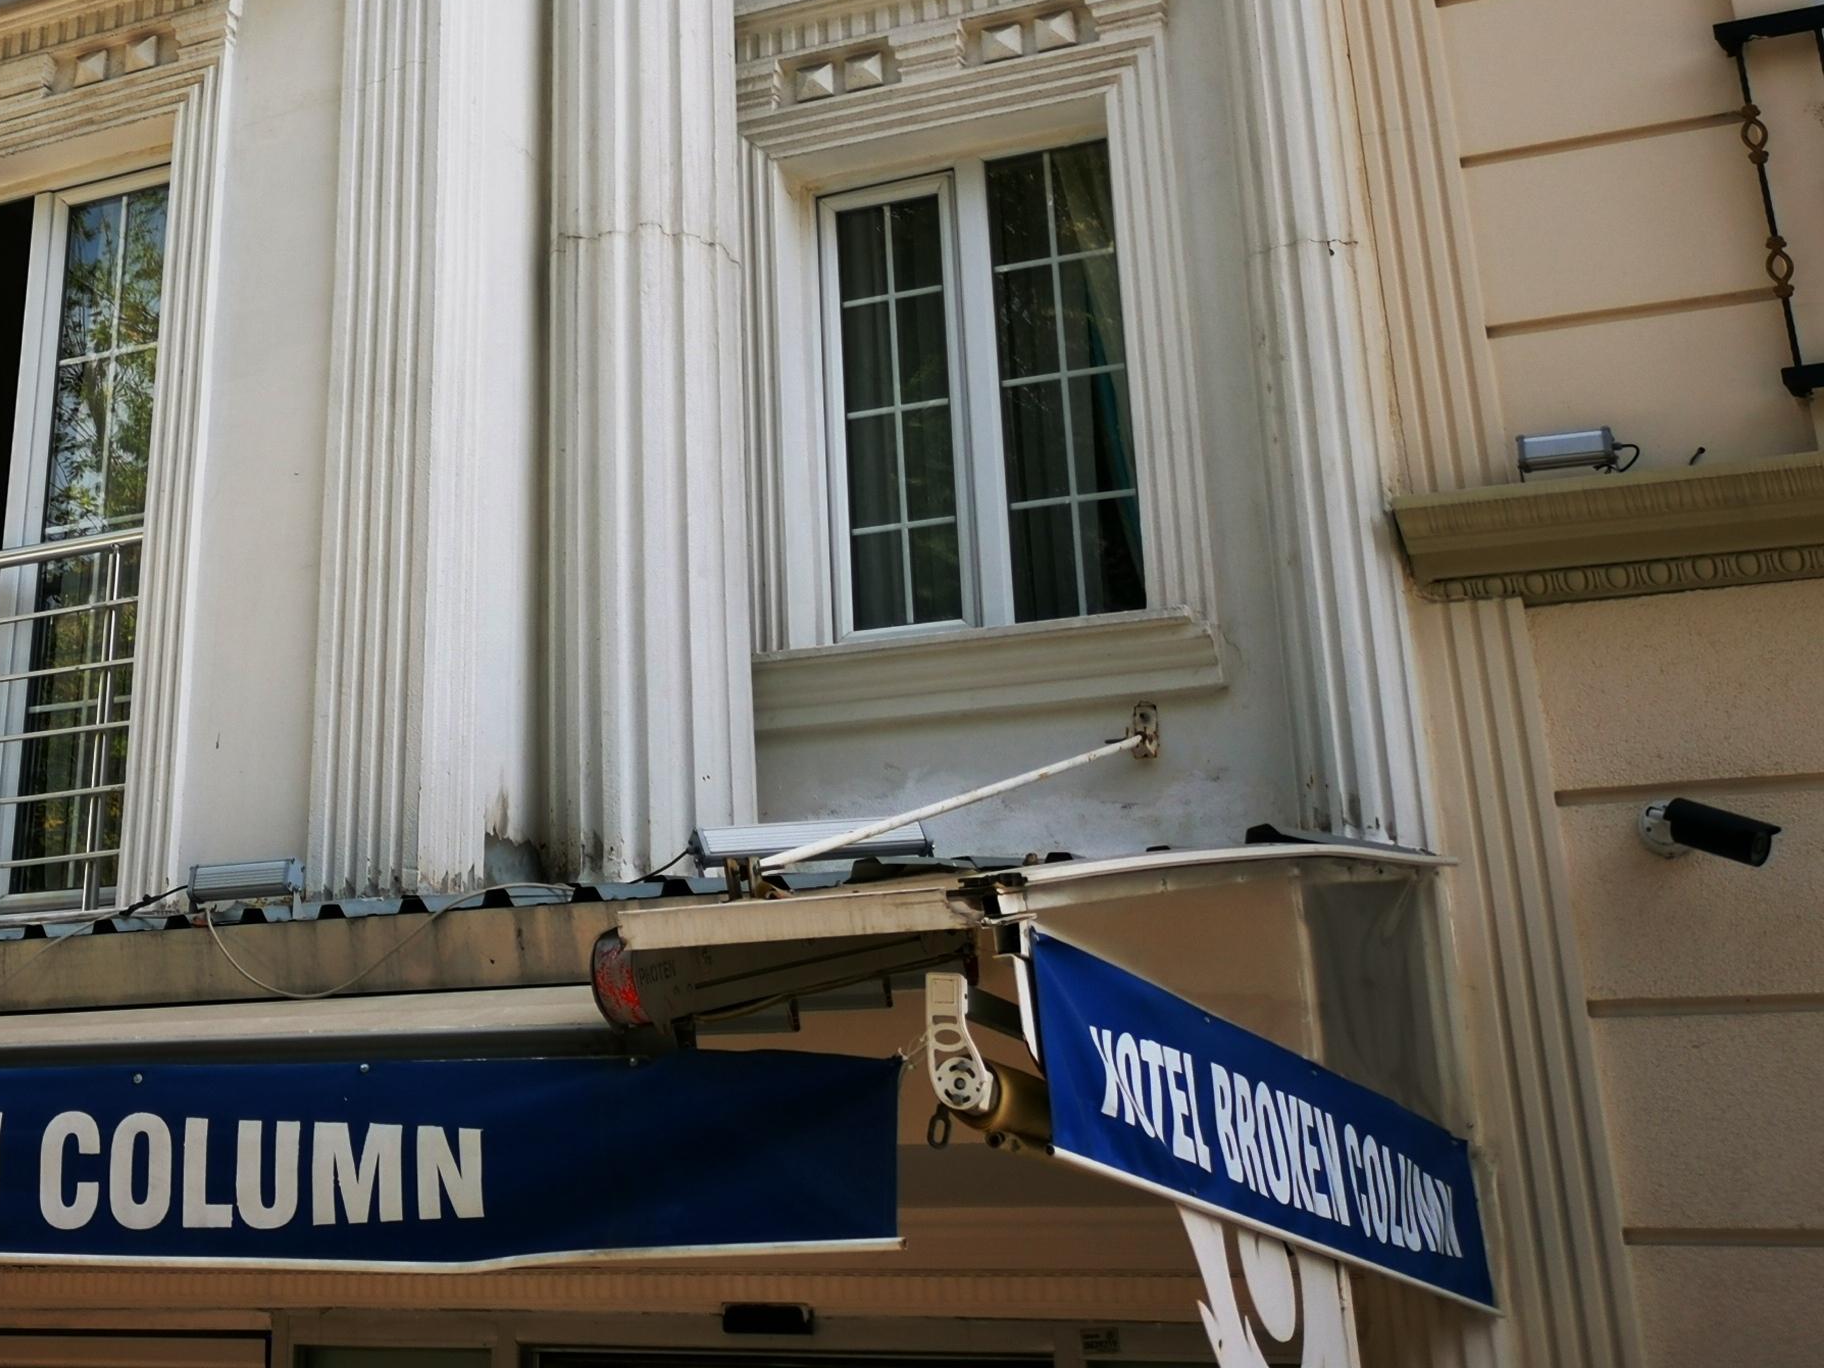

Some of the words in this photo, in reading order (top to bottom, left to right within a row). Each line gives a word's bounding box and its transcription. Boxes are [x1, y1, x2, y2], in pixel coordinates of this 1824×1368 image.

[39, 1110, 485, 1230] COLUMN
[1211, 1062, 1351, 1227] BROKEN
[1344, 1123, 1464, 1259] COLUMN
